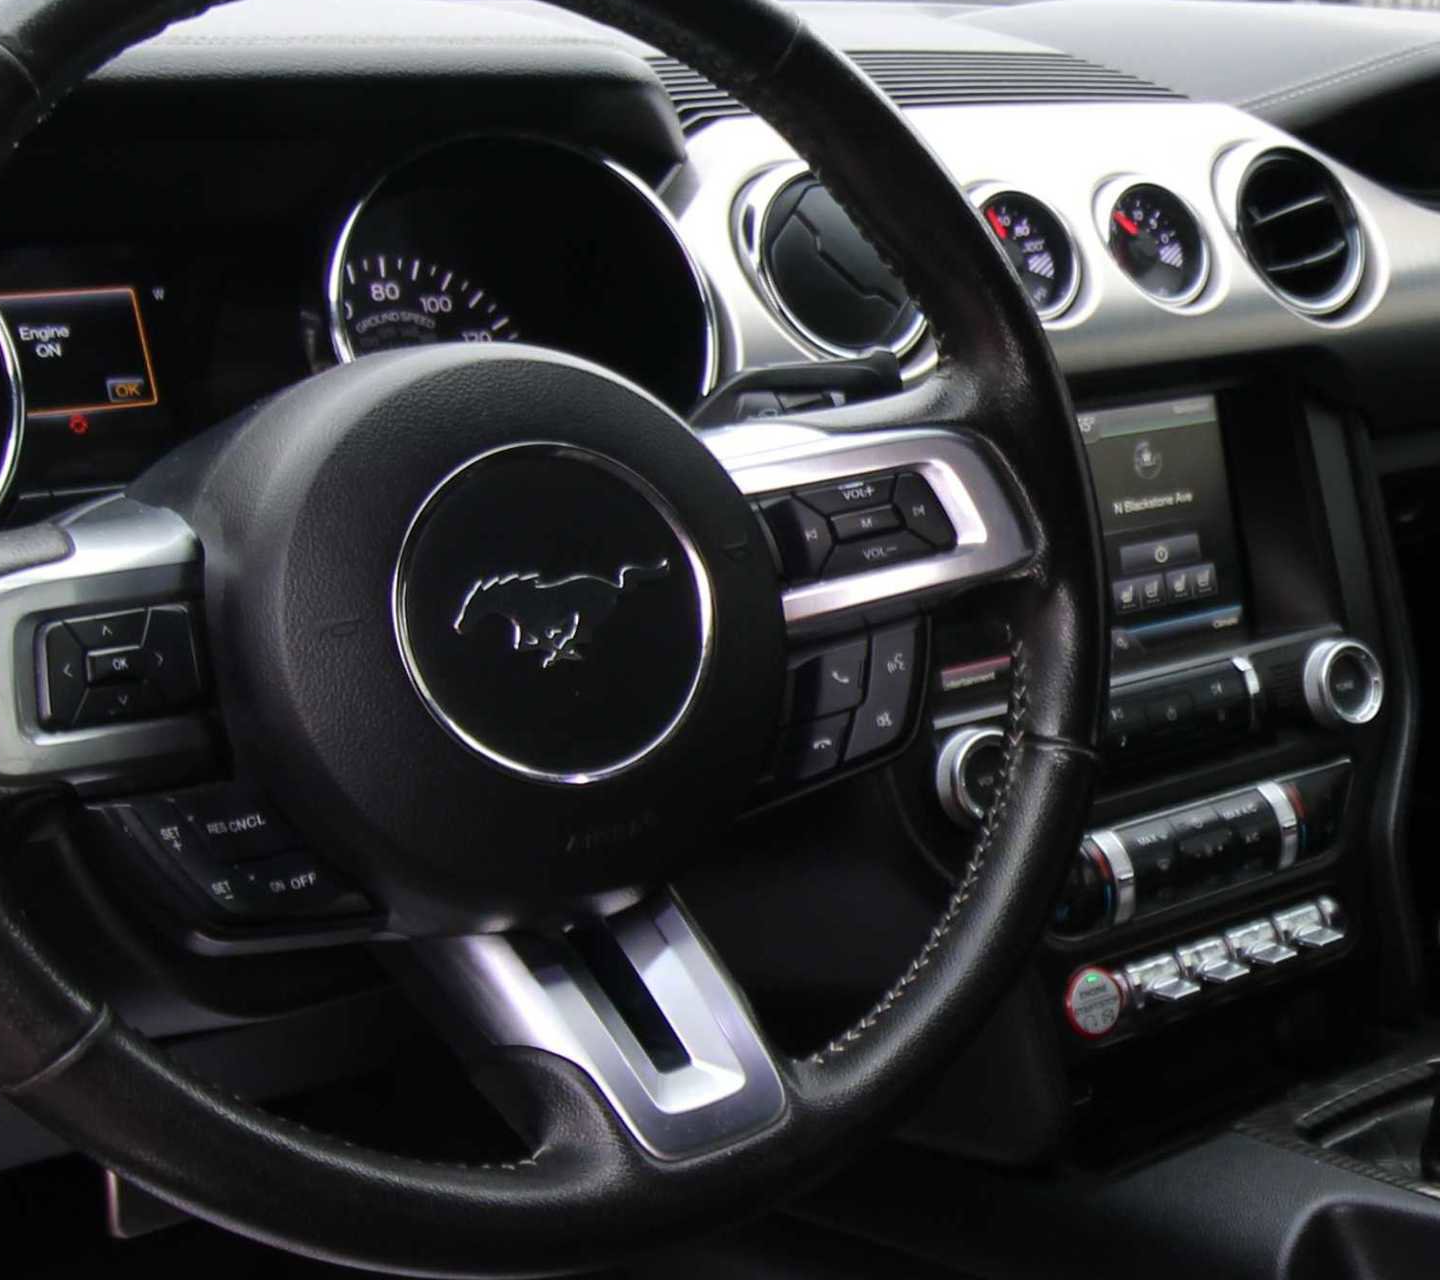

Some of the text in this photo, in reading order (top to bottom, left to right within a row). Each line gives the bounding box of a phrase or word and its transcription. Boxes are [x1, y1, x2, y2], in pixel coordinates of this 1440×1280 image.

[370, 283, 400, 302] 80
[420, 296, 453, 314] 100
[356, 311, 437, 334] GROUND SPEED
[18, 325, 71, 342] Engine
[36, 344, 63, 358] ON
[115, 383, 142, 398] OK
[1124, 497, 1173, 513] Blackstone
[861, 519, 873, 527] M
[112, 656, 130, 670] OK
[228, 813, 267, 832] CNCL
[290, 872, 317, 890] OFF
